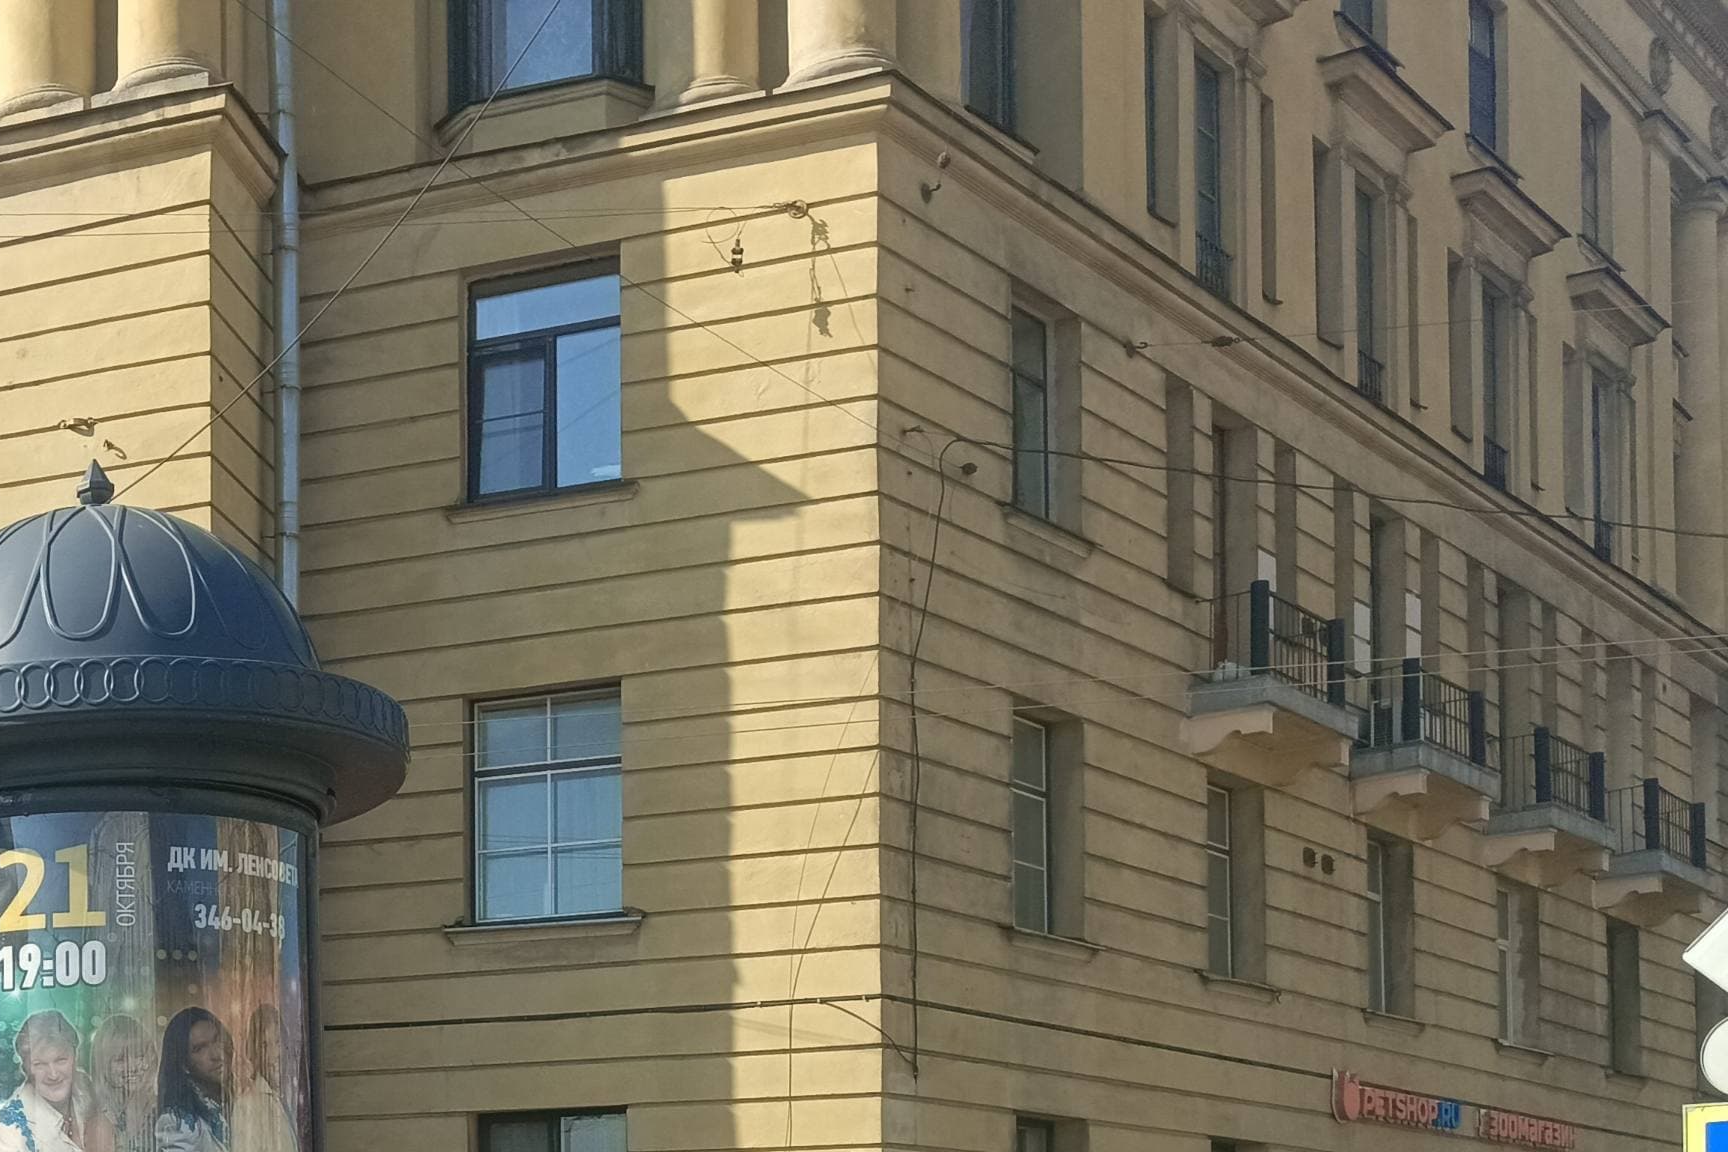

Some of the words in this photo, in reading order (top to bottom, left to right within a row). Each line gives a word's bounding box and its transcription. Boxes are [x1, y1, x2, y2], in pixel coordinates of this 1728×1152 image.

[167, 846, 196, 872] ДК
[200, 849, 232, 873] ИМ.
[116, 842, 136, 927] ОКТЯБРЯ
[194, 903, 285, 940] 346-04-38
